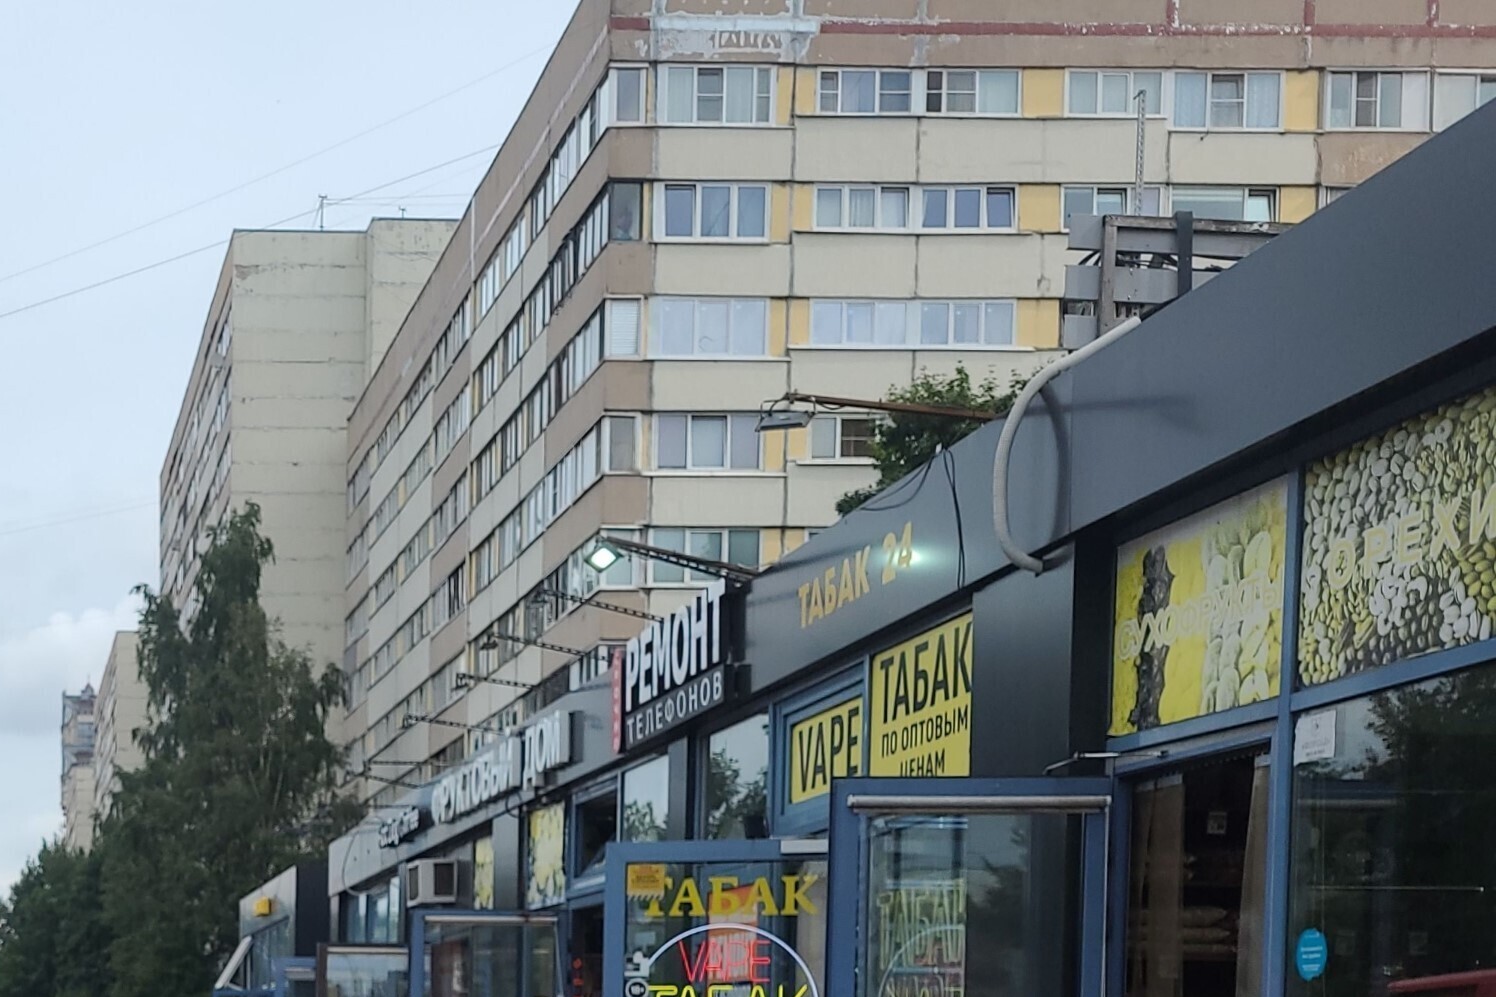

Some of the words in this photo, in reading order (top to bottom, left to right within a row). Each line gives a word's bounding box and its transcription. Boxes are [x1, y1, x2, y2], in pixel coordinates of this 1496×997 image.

[798, 545, 871, 629] ТАБАК
[881, 521, 912, 585] 24
[1328, 482, 1496, 590] ОРЕХИ
[625, 577, 726, 712] РЕМОНТ
[1117, 570, 1282, 661] СУХОФРУКТЫ
[626, 670, 723, 745] ТЕЛЕФОНОВ
[880, 622, 972, 724] ТАБАК
[523, 710, 561, 791] ДОМ
[799, 706, 859, 793] VAPE
[881, 730, 897, 758] ПО
[901, 704, 968, 751] ОПТОВЫМ
[678, 939, 771, 983] VAPE
